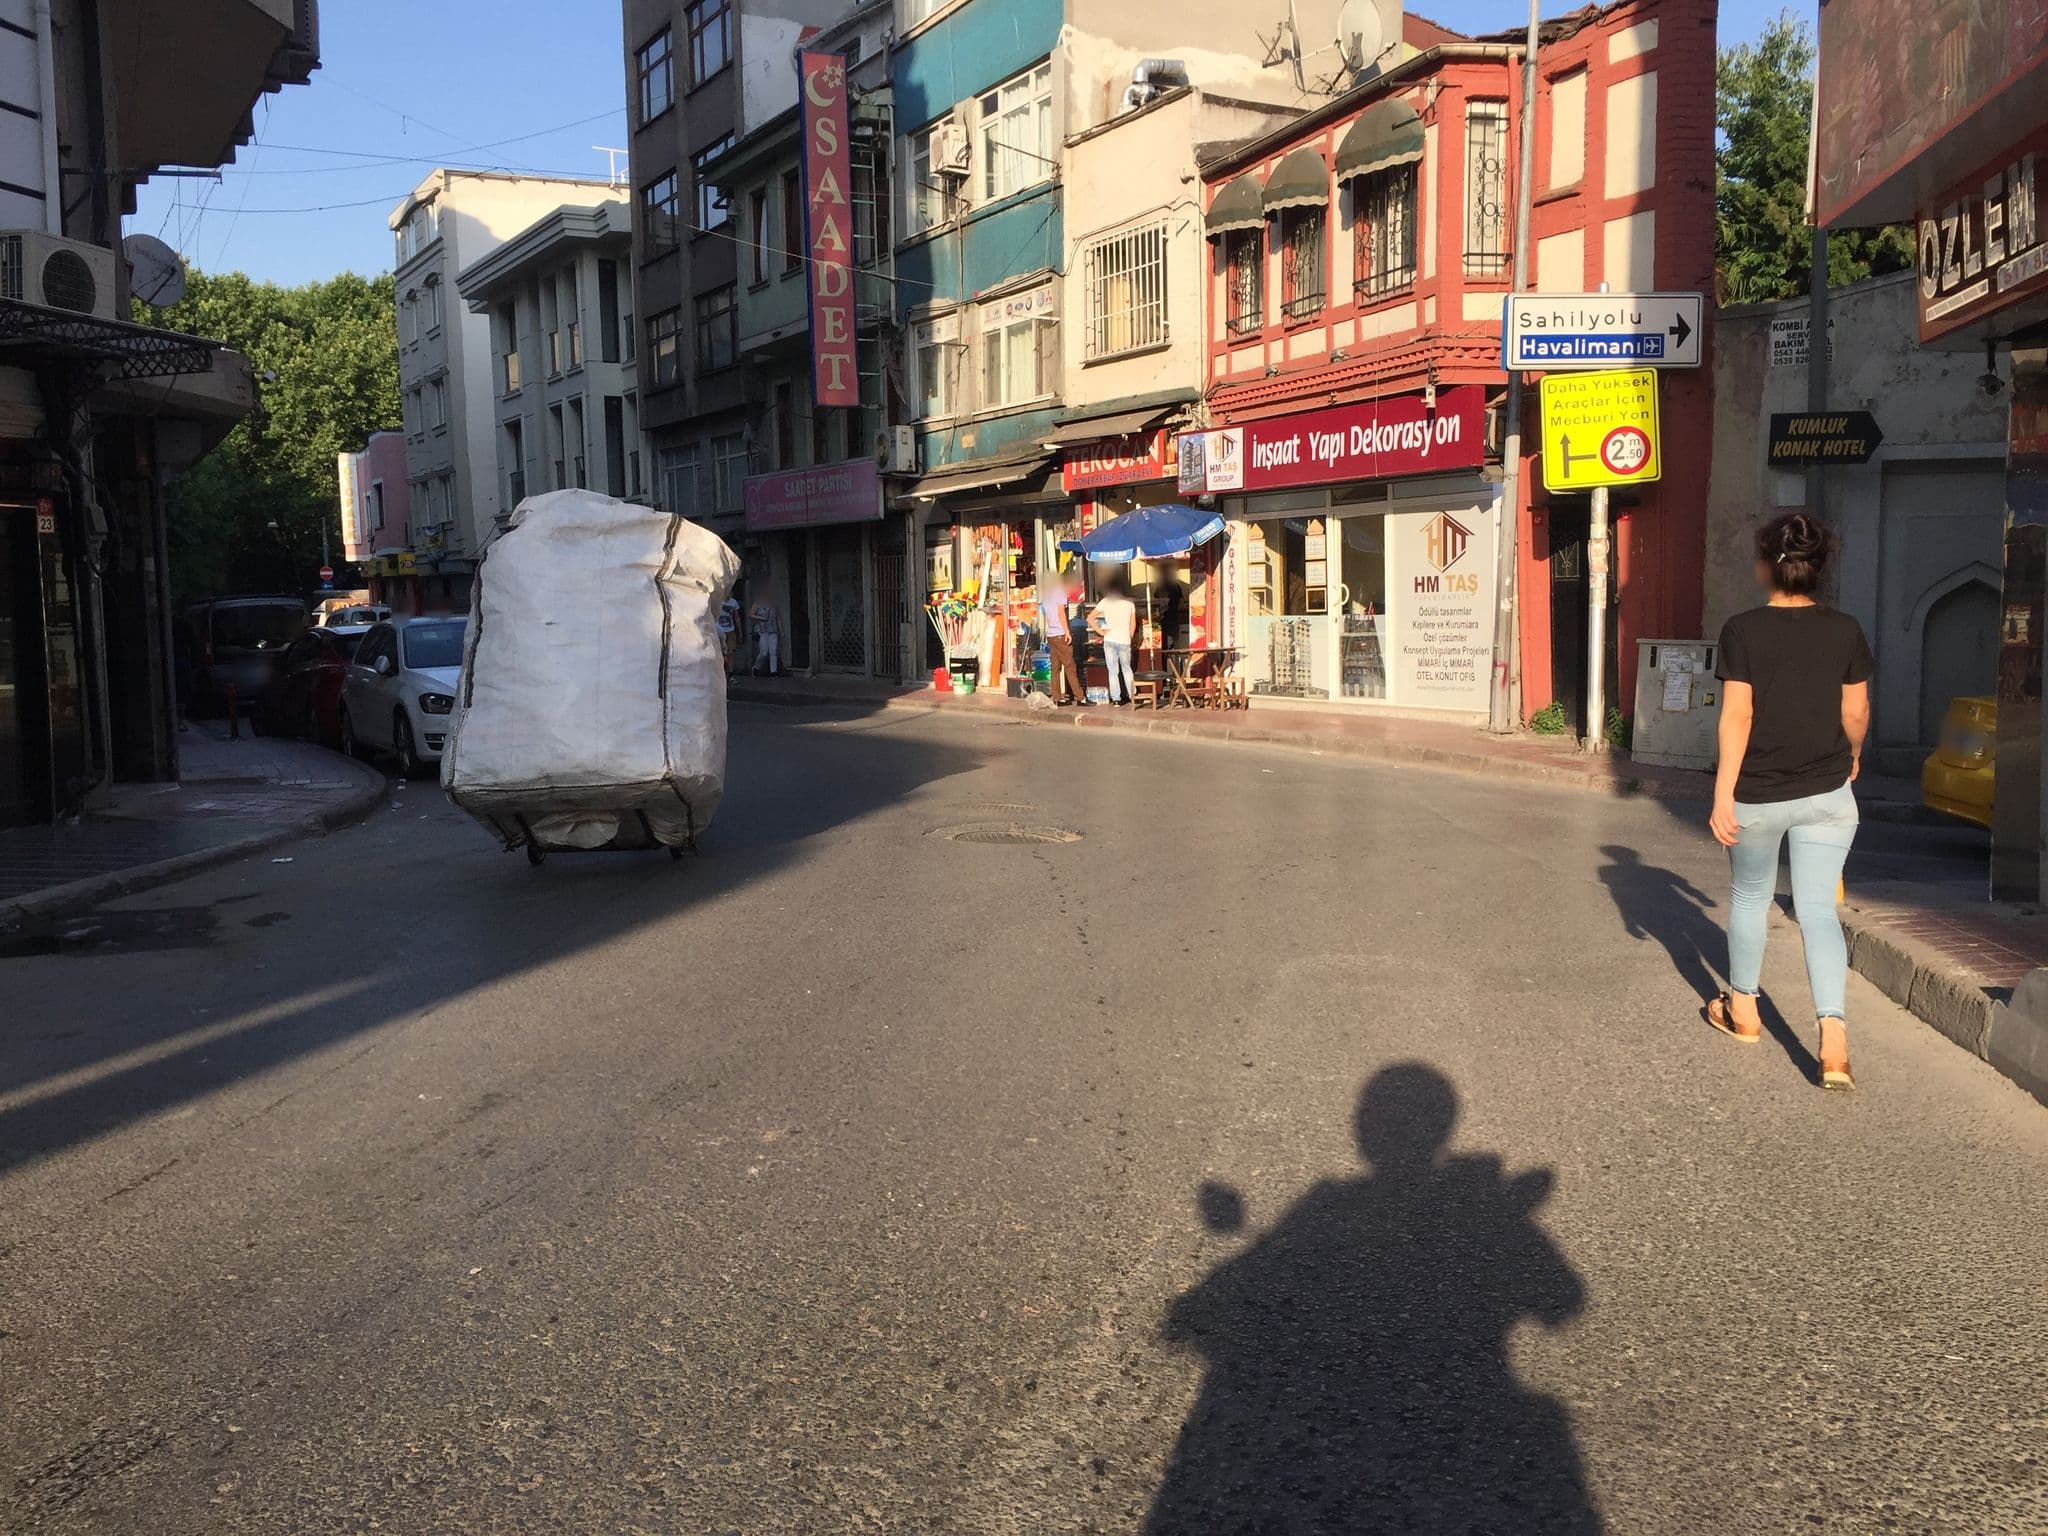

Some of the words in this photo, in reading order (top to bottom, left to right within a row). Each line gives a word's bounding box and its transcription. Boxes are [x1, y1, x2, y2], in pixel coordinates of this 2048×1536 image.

[812, 117, 851, 391] SAADET
[1520, 309, 1642, 330] Sahilyolu
[1522, 337, 1641, 355] Havalimanı
[1774, 340, 1805, 349] BAKIM
[1773, 349, 1793, 357] 0543
[1773, 357, 1793, 365] 0539
[1548, 383, 1587, 395] Daha
[1553, 397, 1610, 411] Araçlar
[1550, 412, 1614, 427] Mecburi
[1788, 417, 1849, 434] KUMLUK
[1252, 433, 1300, 471] İnşaat
[1308, 431, 1345, 468] Yapı
[1350, 413, 1460, 457] Dekorasyon
[1773, 440, 1819, 457] KONAK
[1823, 439, 1866, 456] HOTEL
[1209, 464, 1222, 474] HM
[1212, 474, 1234, 482] GROUP
[784, 477, 817, 498] SAADET
[40, 518, 52, 530] 23
[1414, 575, 1439, 593] HM
[1445, 574, 1478, 596] TAŞ
[1416, 670, 1433, 680] OTEL
[1434, 671, 1459, 681] KONUT
